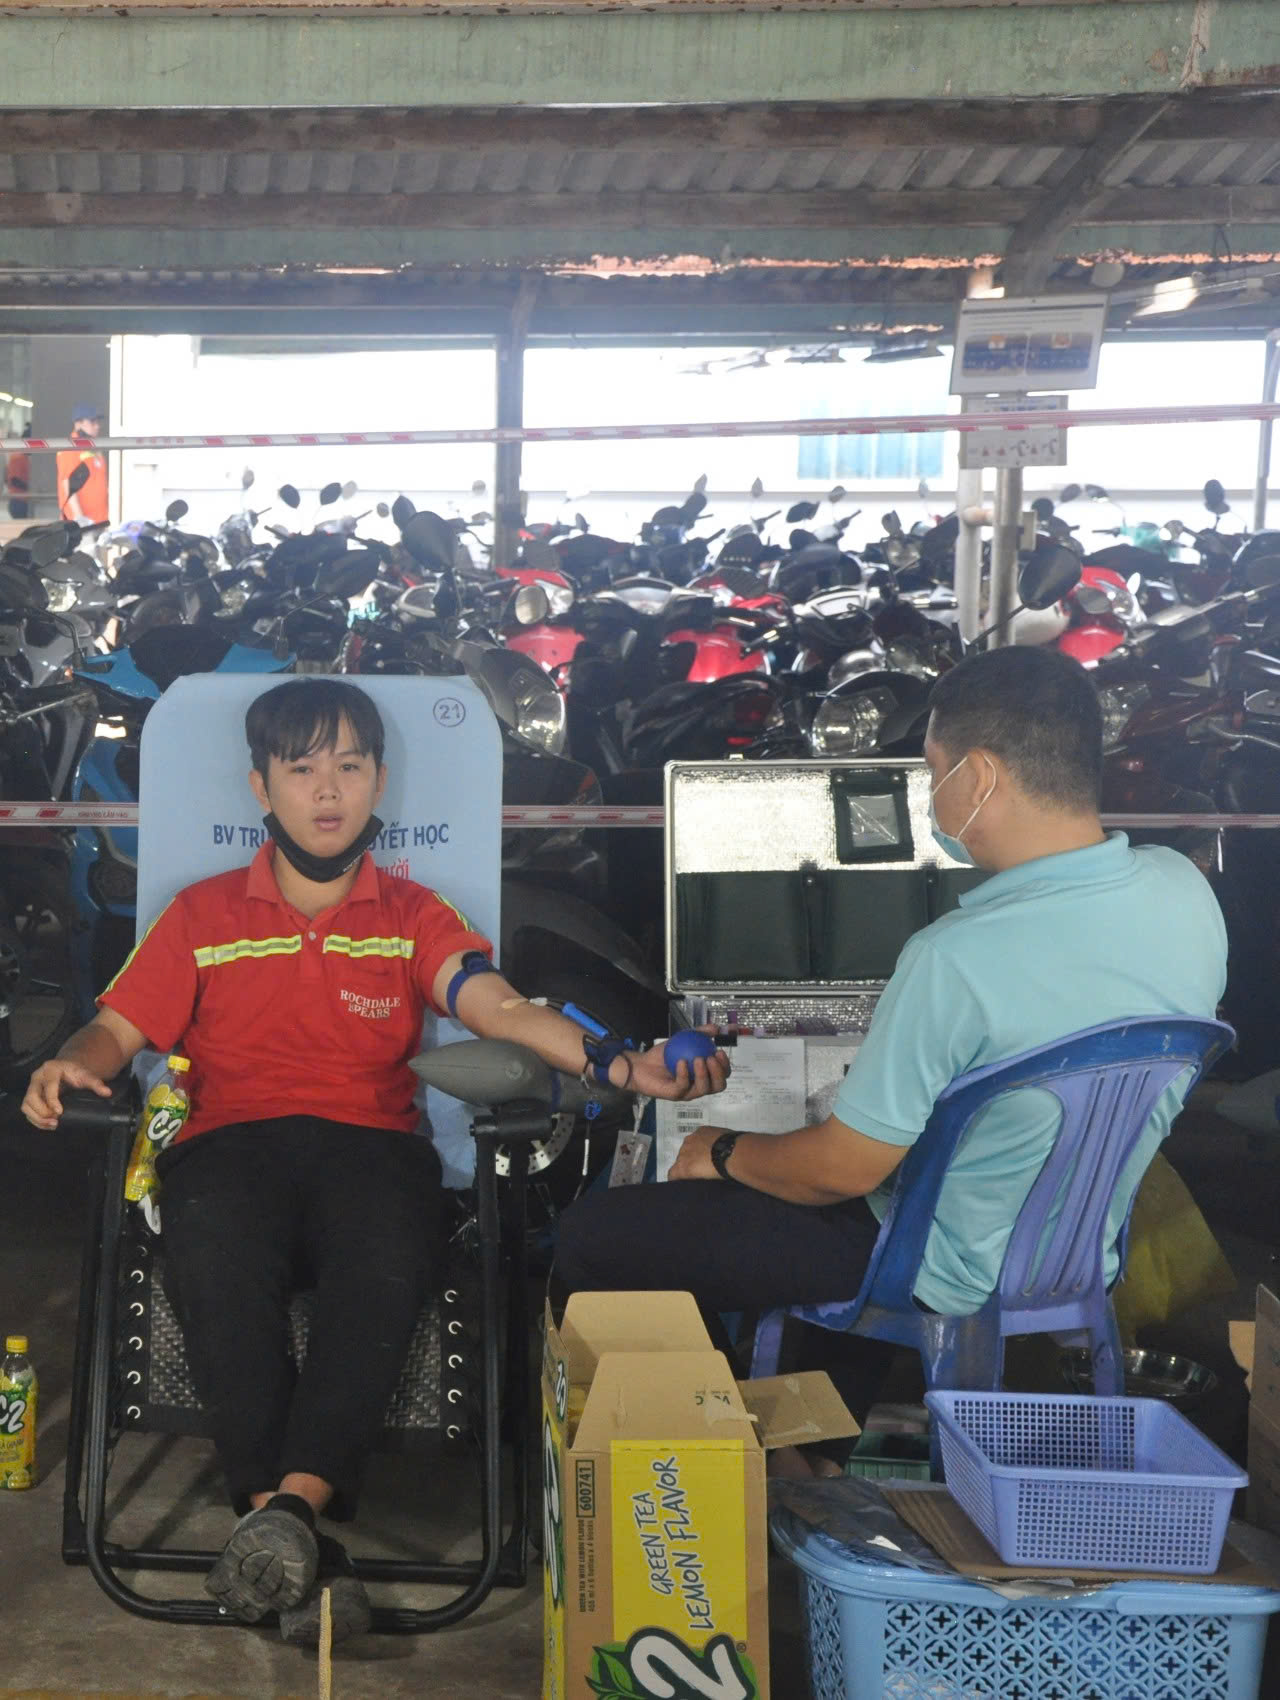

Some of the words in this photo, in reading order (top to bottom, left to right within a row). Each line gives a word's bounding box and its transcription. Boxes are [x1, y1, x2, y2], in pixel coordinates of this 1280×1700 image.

[439, 703, 461, 720] 21
[213, 824, 235, 845] BV
[413, 823, 449, 850] HỌC
[340, 989, 401, 1008] ROCHDALE
[348, 1003, 391, 1018] SPEARS
[147, 1109, 183, 1150] C2
[578, 1467, 592, 1511] 600741
[652, 1456, 698, 1541] FLAVOR
[632, 1492, 658, 1529] TEA
[640, 1533, 674, 1595] GREEN
[671, 1552, 715, 1629] LEMON
[630, 1635, 747, 1700] 2
